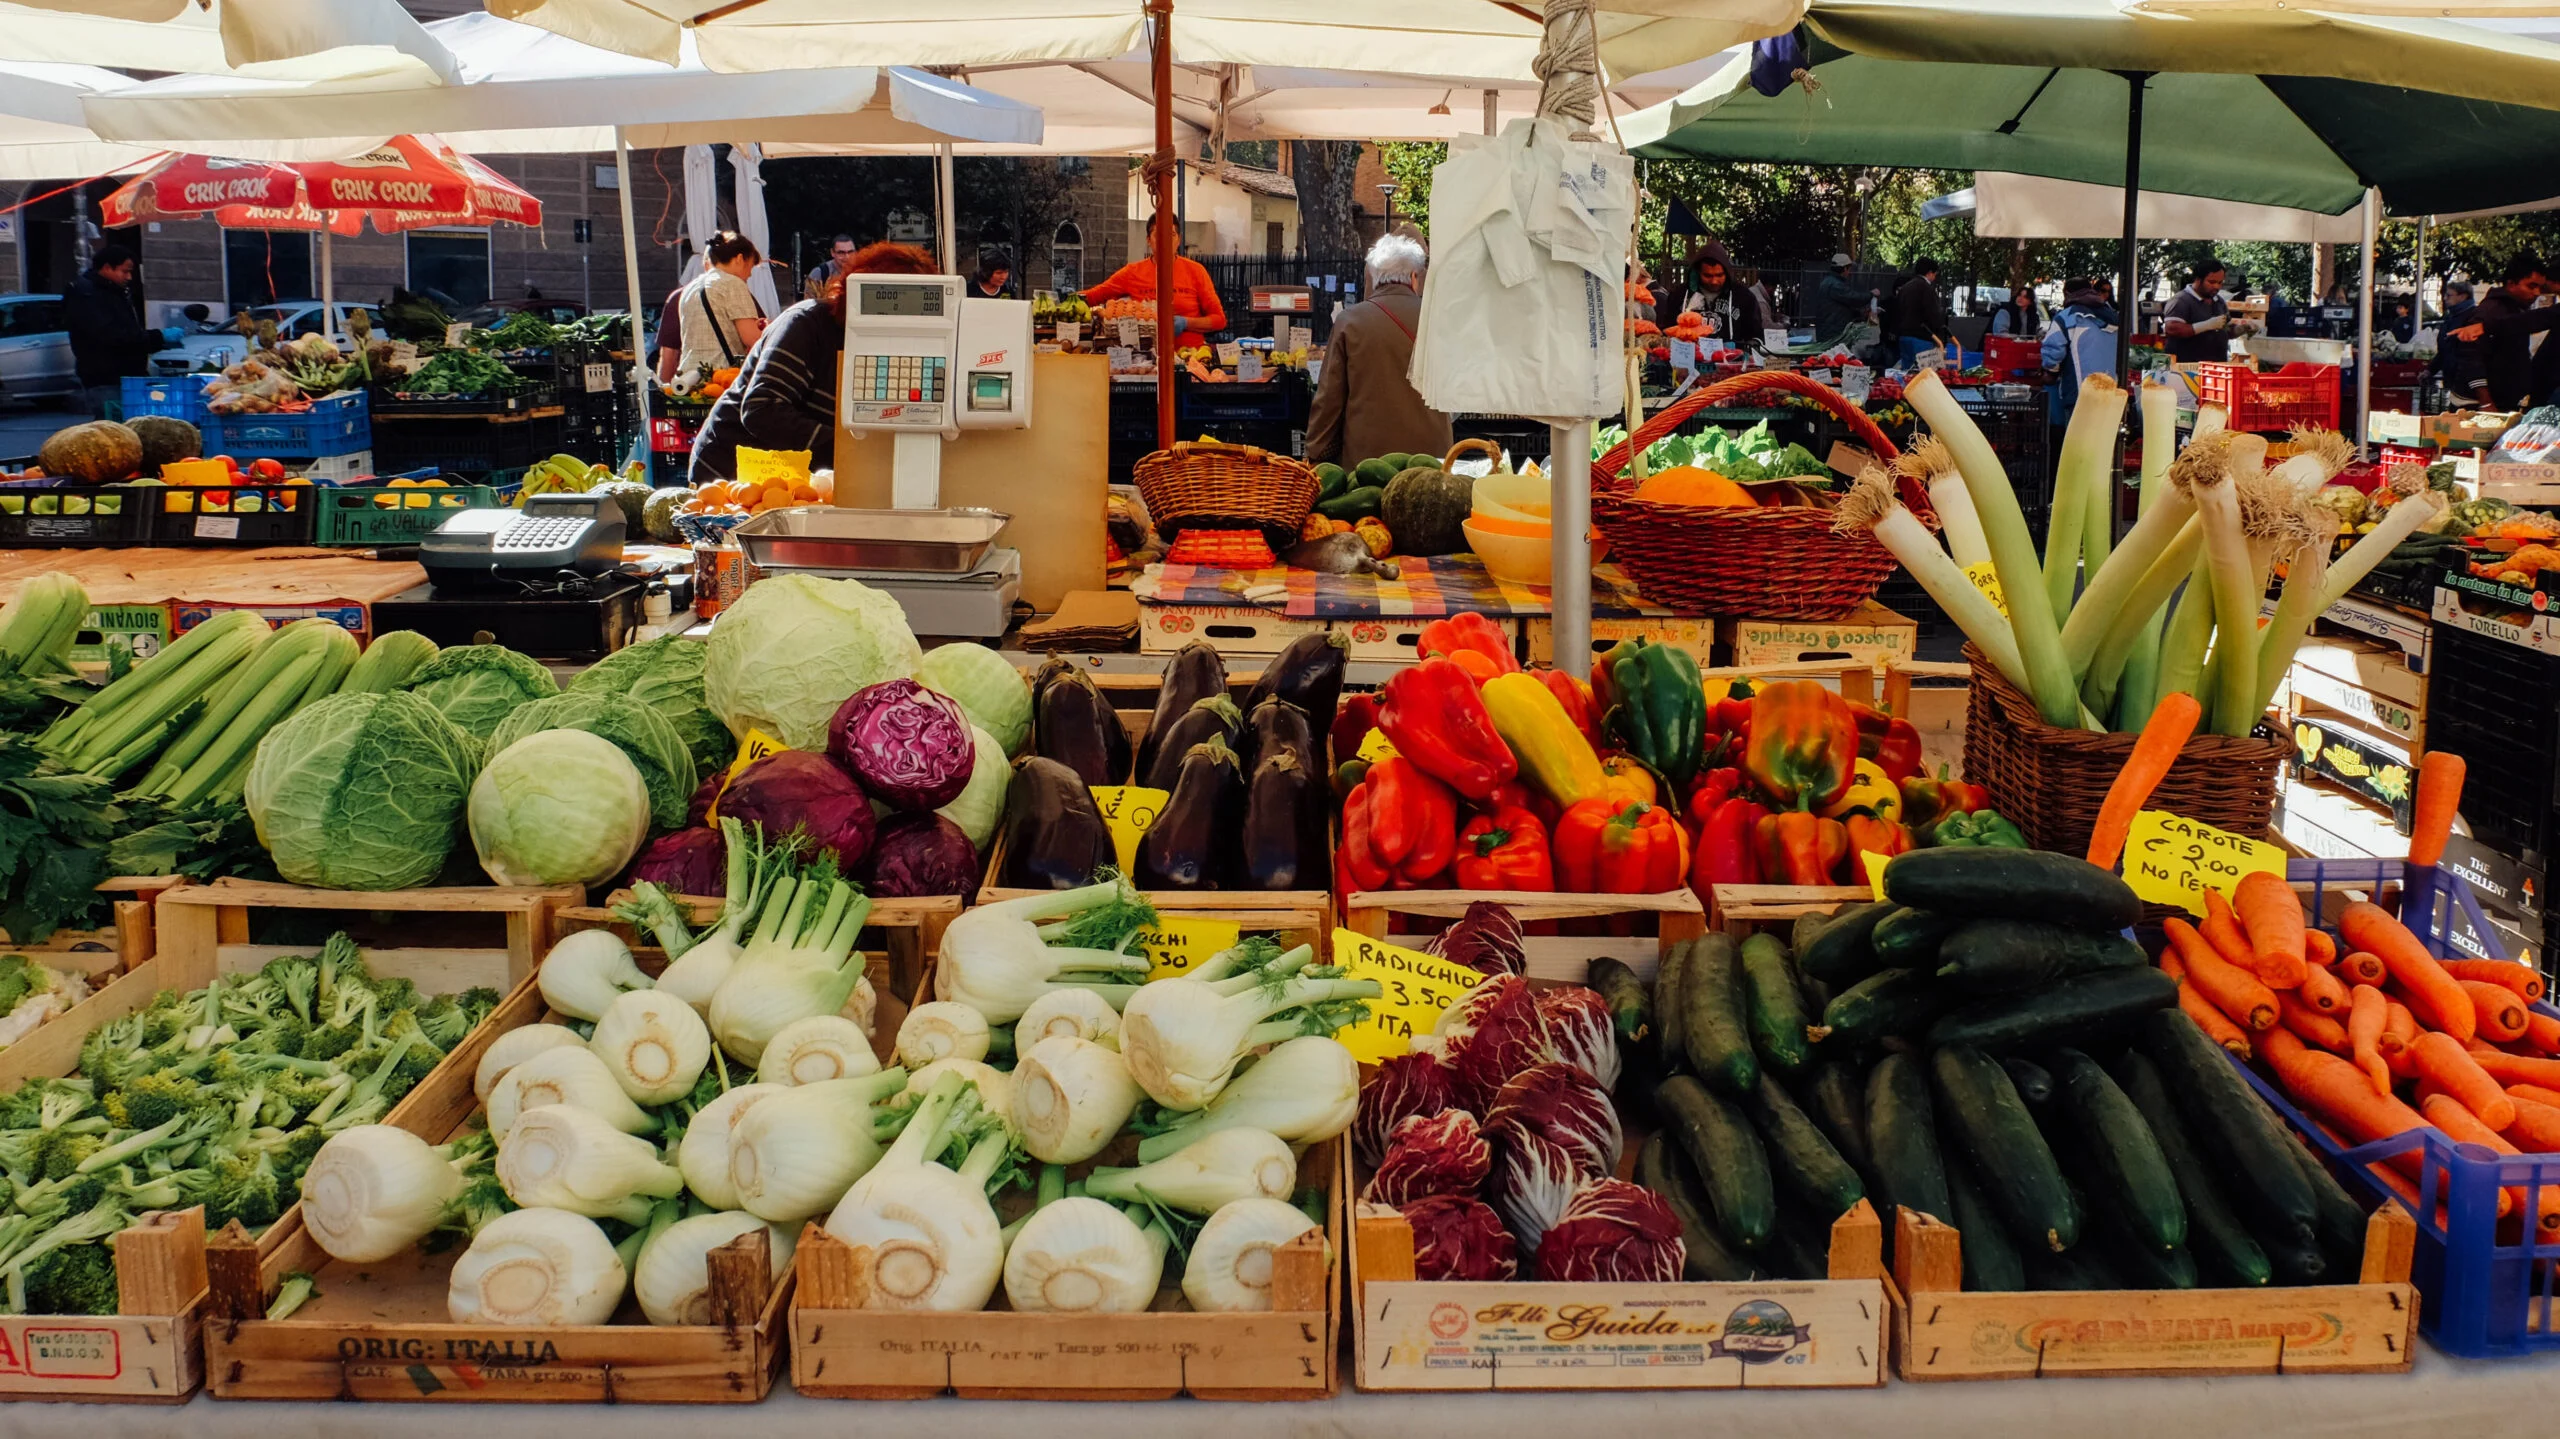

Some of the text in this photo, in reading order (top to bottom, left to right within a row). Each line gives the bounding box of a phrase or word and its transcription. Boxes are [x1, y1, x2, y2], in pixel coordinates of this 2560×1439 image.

[184, 177, 271, 204] CRIK CROK
[331, 178, 434, 203] CRIK CROK
[2458, 577, 2497, 596] natura
[1750, 630, 1899, 649] Bosco Grande
[2468, 616, 2520, 641] TORELLO
[2159, 819, 2253, 856] CAROTE
[2141, 861, 2169, 880] NO
[2469, 856, 2491, 876] THE
[2452, 862, 2509, 898] EXCELLENT
[1358, 943, 1477, 989] RADICCHIO
[1391, 981, 1453, 1010] 3.50
[1377, 1013, 1413, 1040] ITA
[1545, 1304, 1679, 1342] Guida
[337, 1337, 562, 1362] ORIG: ITALIA
[920, 1339, 982, 1353] ITALIA
[1115, 1342, 1140, 1354] 500
[486, 1366, 529, 1381] TARA
